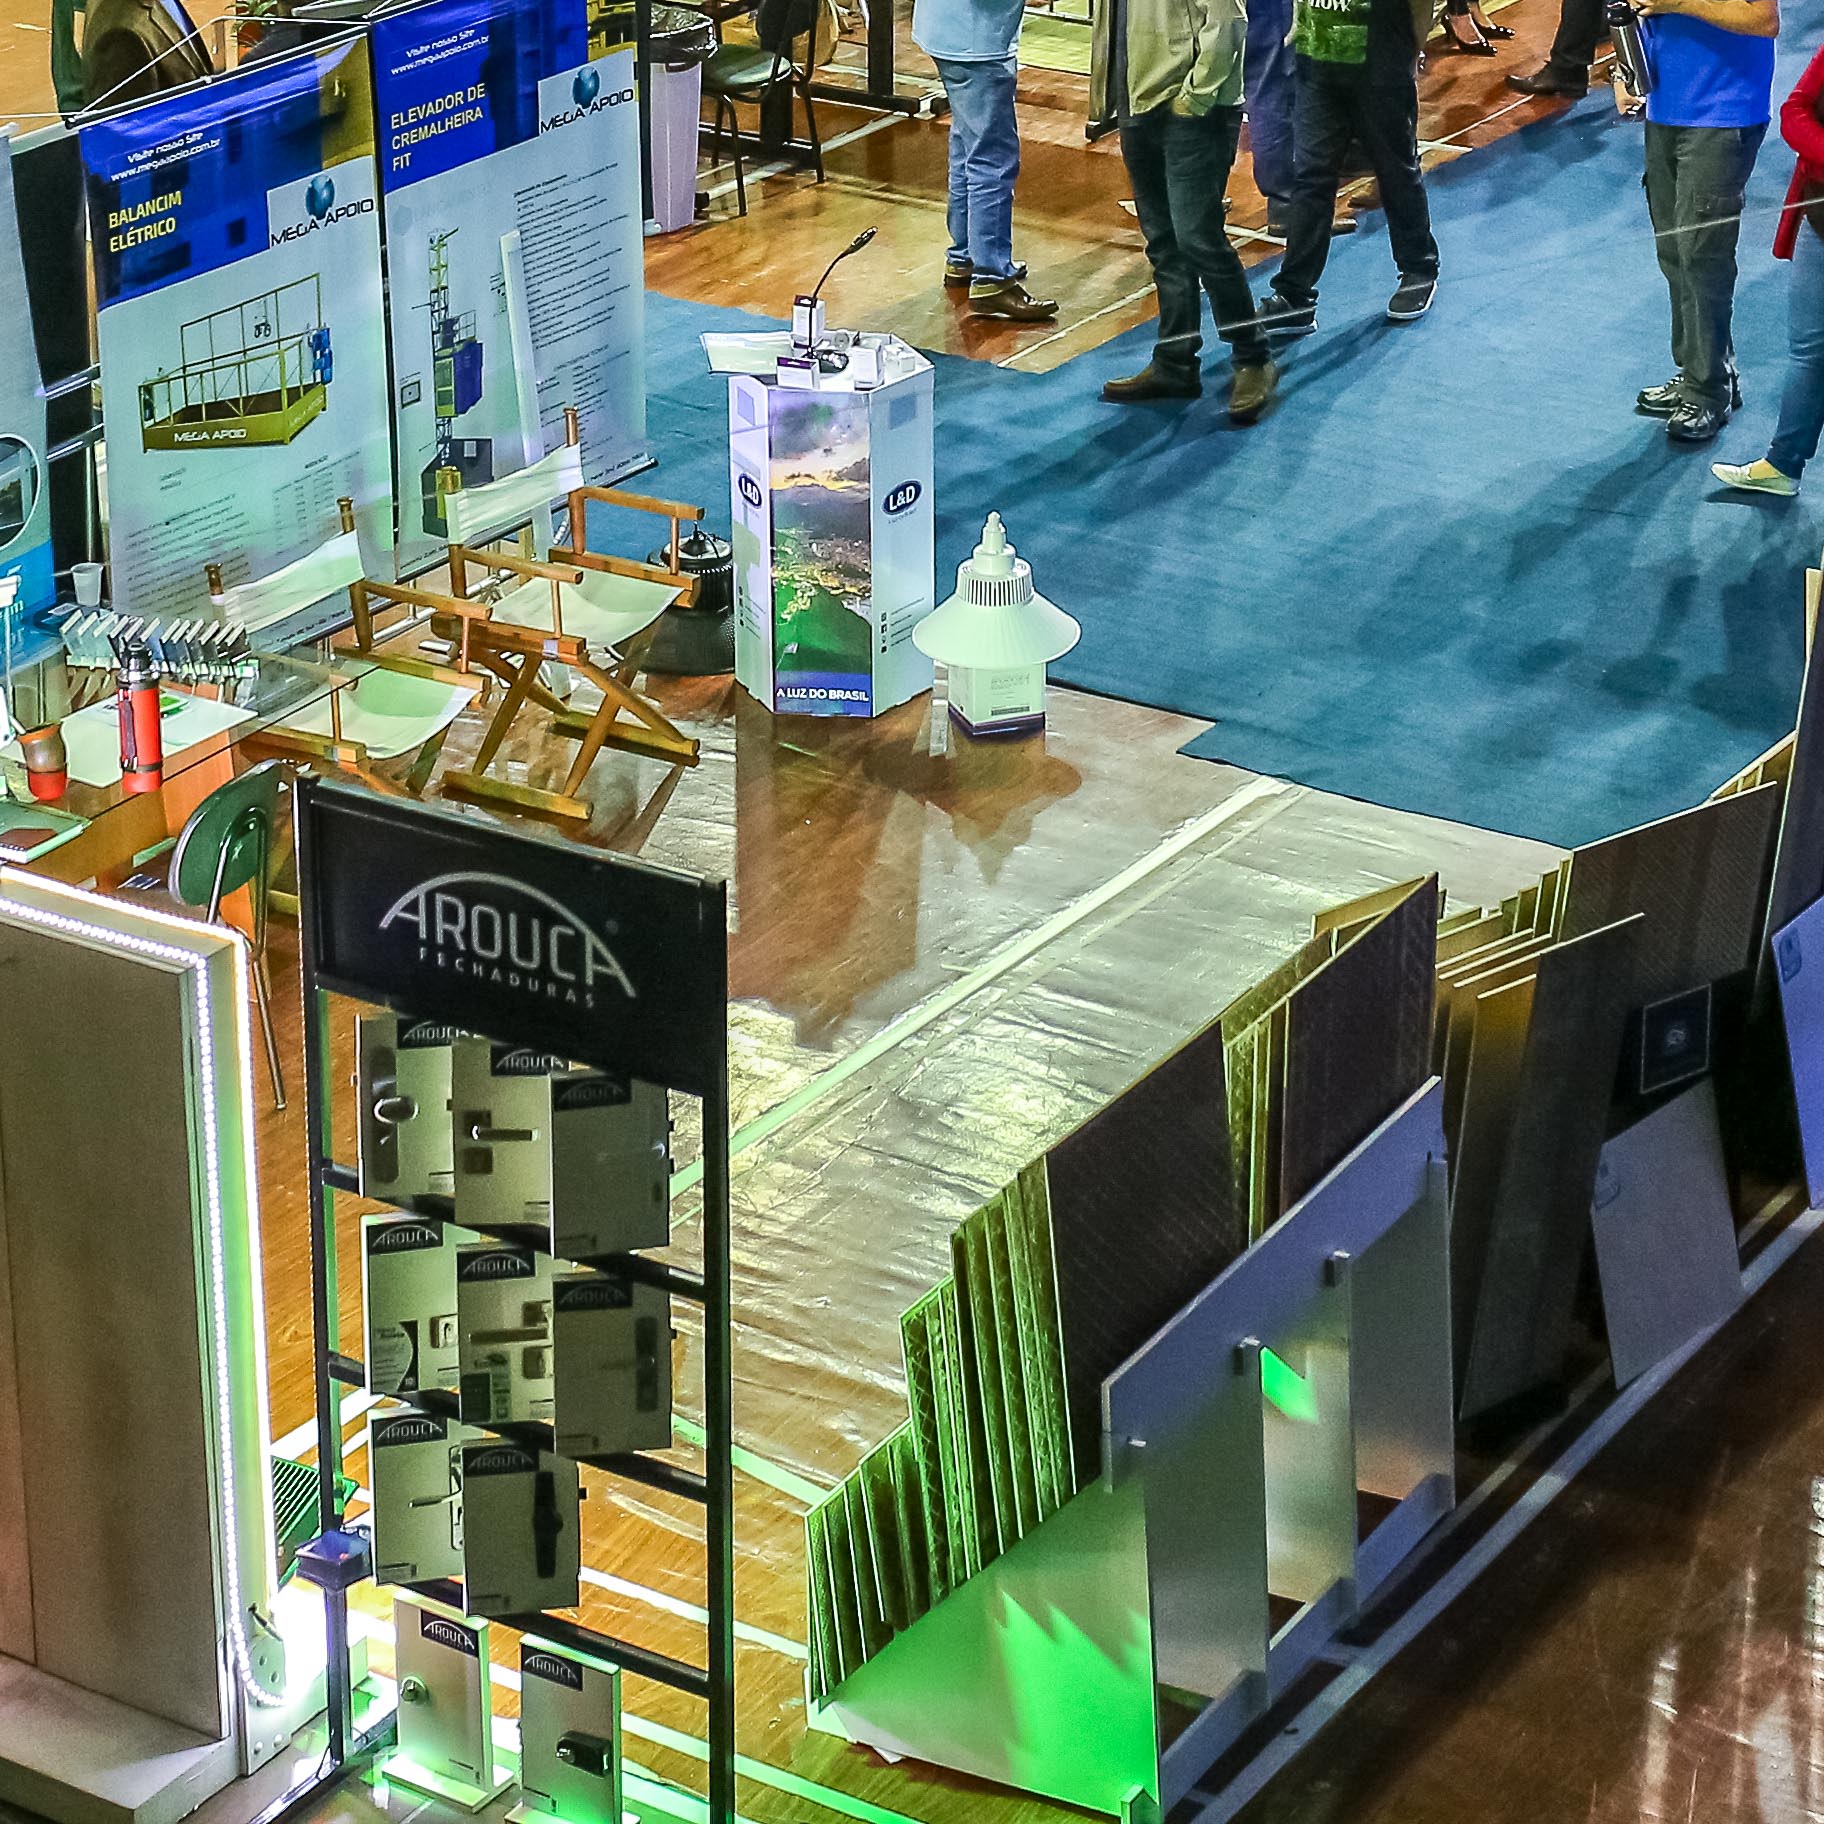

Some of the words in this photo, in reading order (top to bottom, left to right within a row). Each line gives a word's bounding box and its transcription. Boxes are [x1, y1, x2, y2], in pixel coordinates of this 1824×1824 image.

[406, 43, 430, 58] Visite
[431, 35, 458, 50] nosso
[459, 29, 475, 40] Site
[391, 91, 464, 130] ELEVADOR
[467, 83, 485, 102] DE
[540, 109, 585, 134] MEGA
[589, 88, 634, 115] APOIO
[392, 107, 483, 150] CREMALHEIRA
[127, 149, 154, 164] Visite
[156, 138, 184, 155] nosso
[186, 132, 203, 144] Site
[393, 152, 412, 171] FIT
[108, 190, 182, 229] BALANCIM
[270, 220, 321, 248] MEGA
[324, 197, 374, 227] APOIO
[110, 217, 176, 253] ELÉTRICO
[174, 431, 210, 442] MEGA
[212, 428, 246, 440] APOIO
[739, 475, 760, 506] L&D
[888, 485, 916, 512] L&D
[777, 688, 786, 697] A
[787, 688, 807, 700] LUZ
[809, 689, 826, 701] DO
[829, 690, 869, 702] BRASIL
[379, 888, 637, 999] AROUCA
[418, 945, 598, 1010] FECHADURAS
[496, 1054, 564, 1070] AROUCA
[375, 1229, 439, 1249] AROUCA
[463, 1256, 531, 1275] AROUCA
[377, 1420, 443, 1441] AROUCA
[423, 1623, 475, 1649] AROUCA
[524, 1655, 578, 1682] AROUCA
